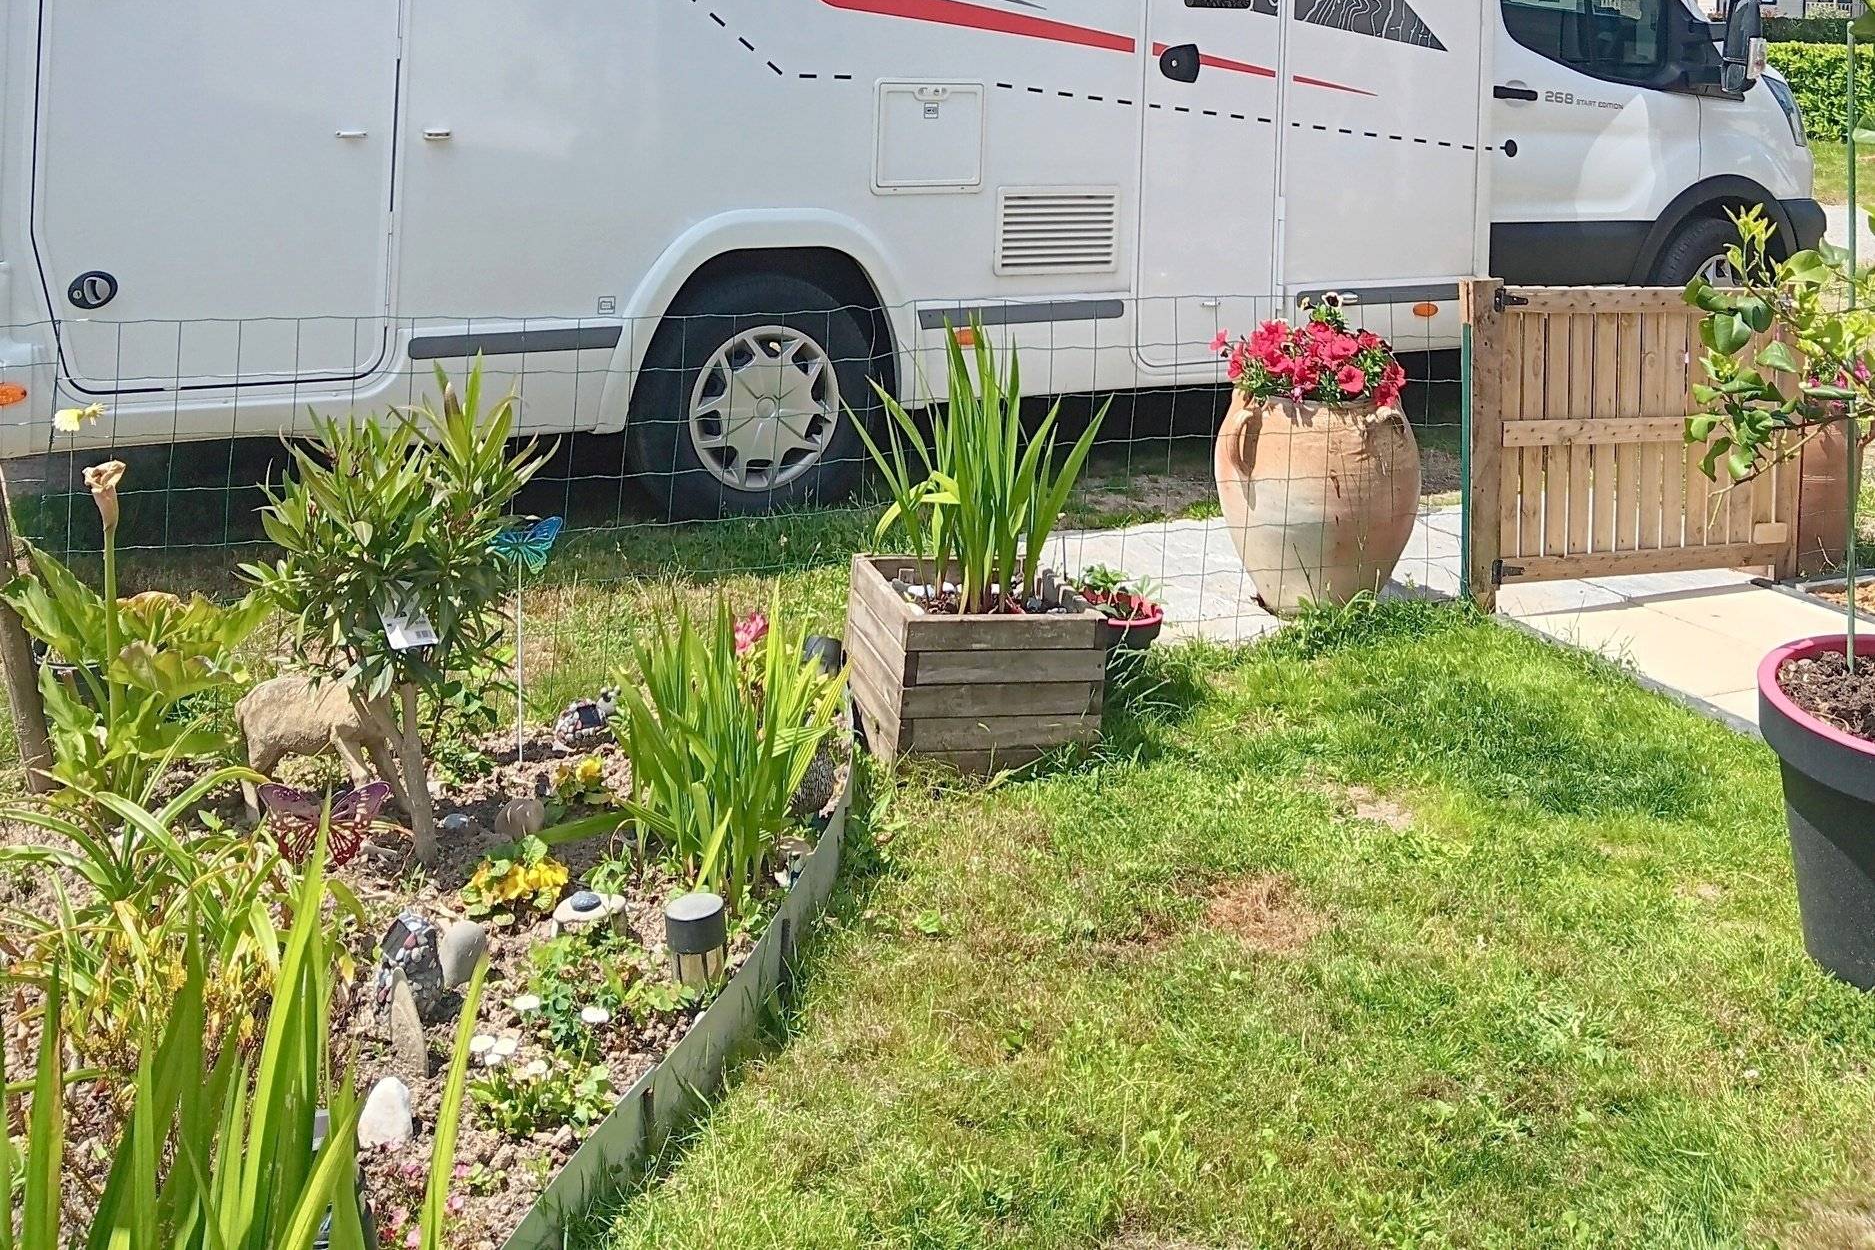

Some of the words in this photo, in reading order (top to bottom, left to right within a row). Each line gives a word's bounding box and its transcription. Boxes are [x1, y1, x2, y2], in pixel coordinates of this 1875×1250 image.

[1544, 90, 1574, 105] 268
[1576, 98, 1597, 107] START
[1597, 101, 1624, 110] EDITION
